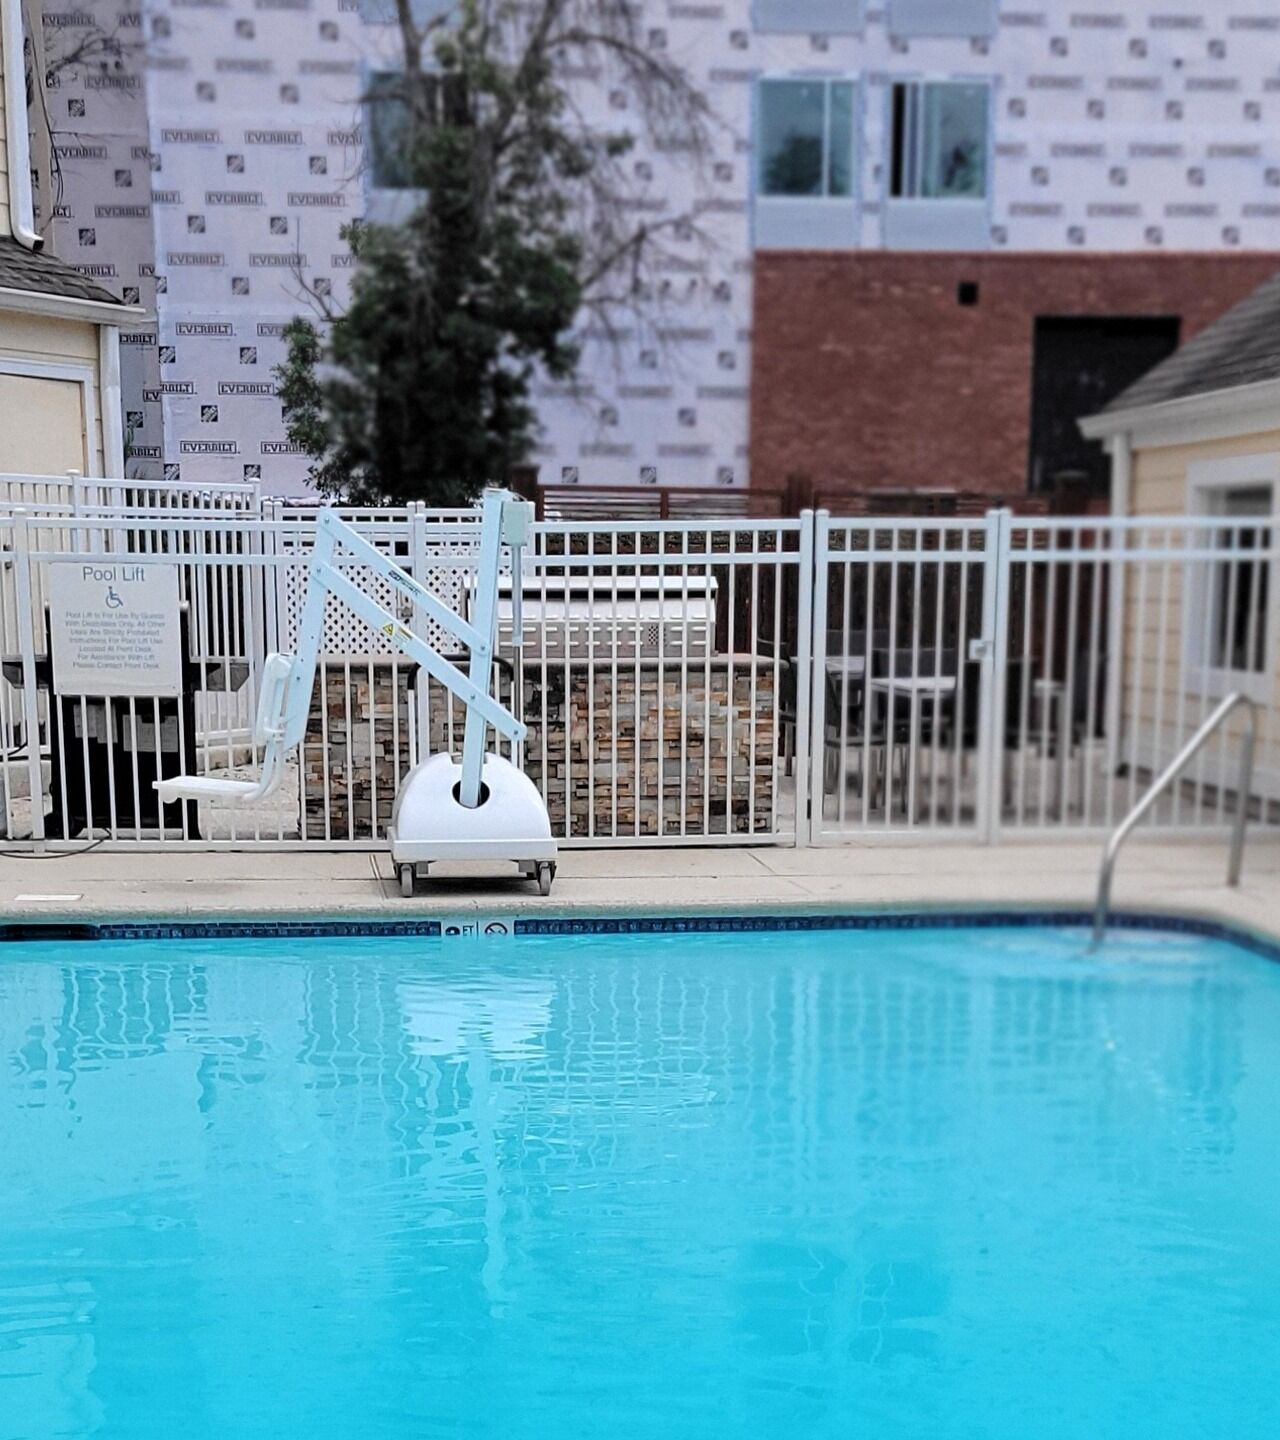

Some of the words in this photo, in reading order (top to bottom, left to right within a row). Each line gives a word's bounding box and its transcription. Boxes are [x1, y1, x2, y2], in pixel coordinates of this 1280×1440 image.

[178, 324, 230, 334] EVERBILT
[220, 384, 272, 394] EVERBILT
[183, 442, 234, 452] EVERBILT
[82, 566, 116, 582] Pool
[122, 566, 145, 582] Lift
